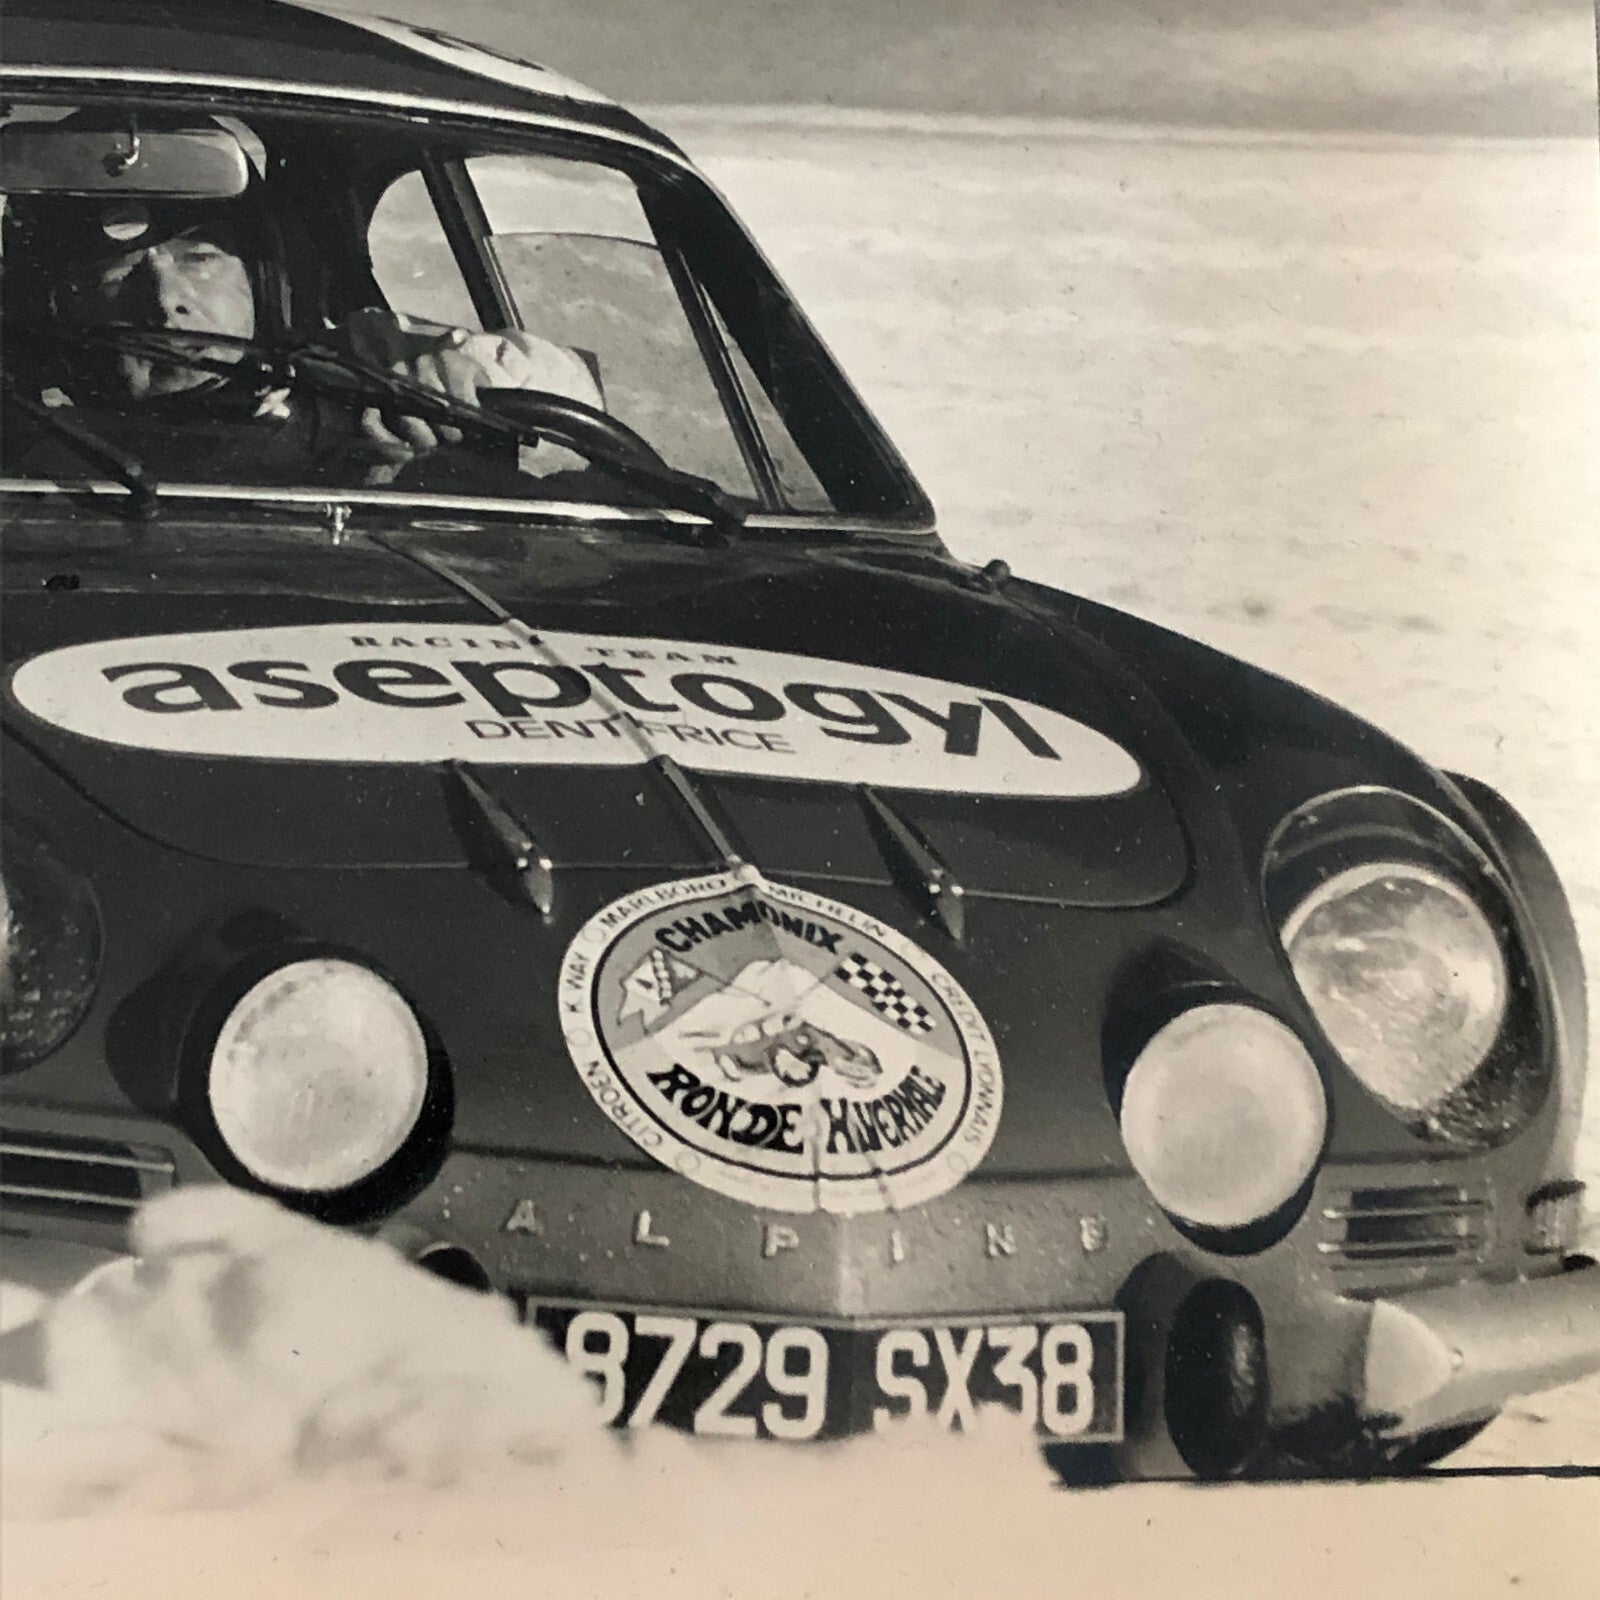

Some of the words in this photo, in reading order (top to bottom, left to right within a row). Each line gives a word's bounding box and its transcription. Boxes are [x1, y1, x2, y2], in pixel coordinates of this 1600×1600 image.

[586, 646, 739, 665] TEAM
[101, 658, 1062, 760] aseptogyl
[655, 900, 843, 954] CHAMONIX
[646, 1062, 803, 1154] RONDE
[506, 1200, 1107, 1262] ALPINE
[565, 1312, 829, 1440] 8729
